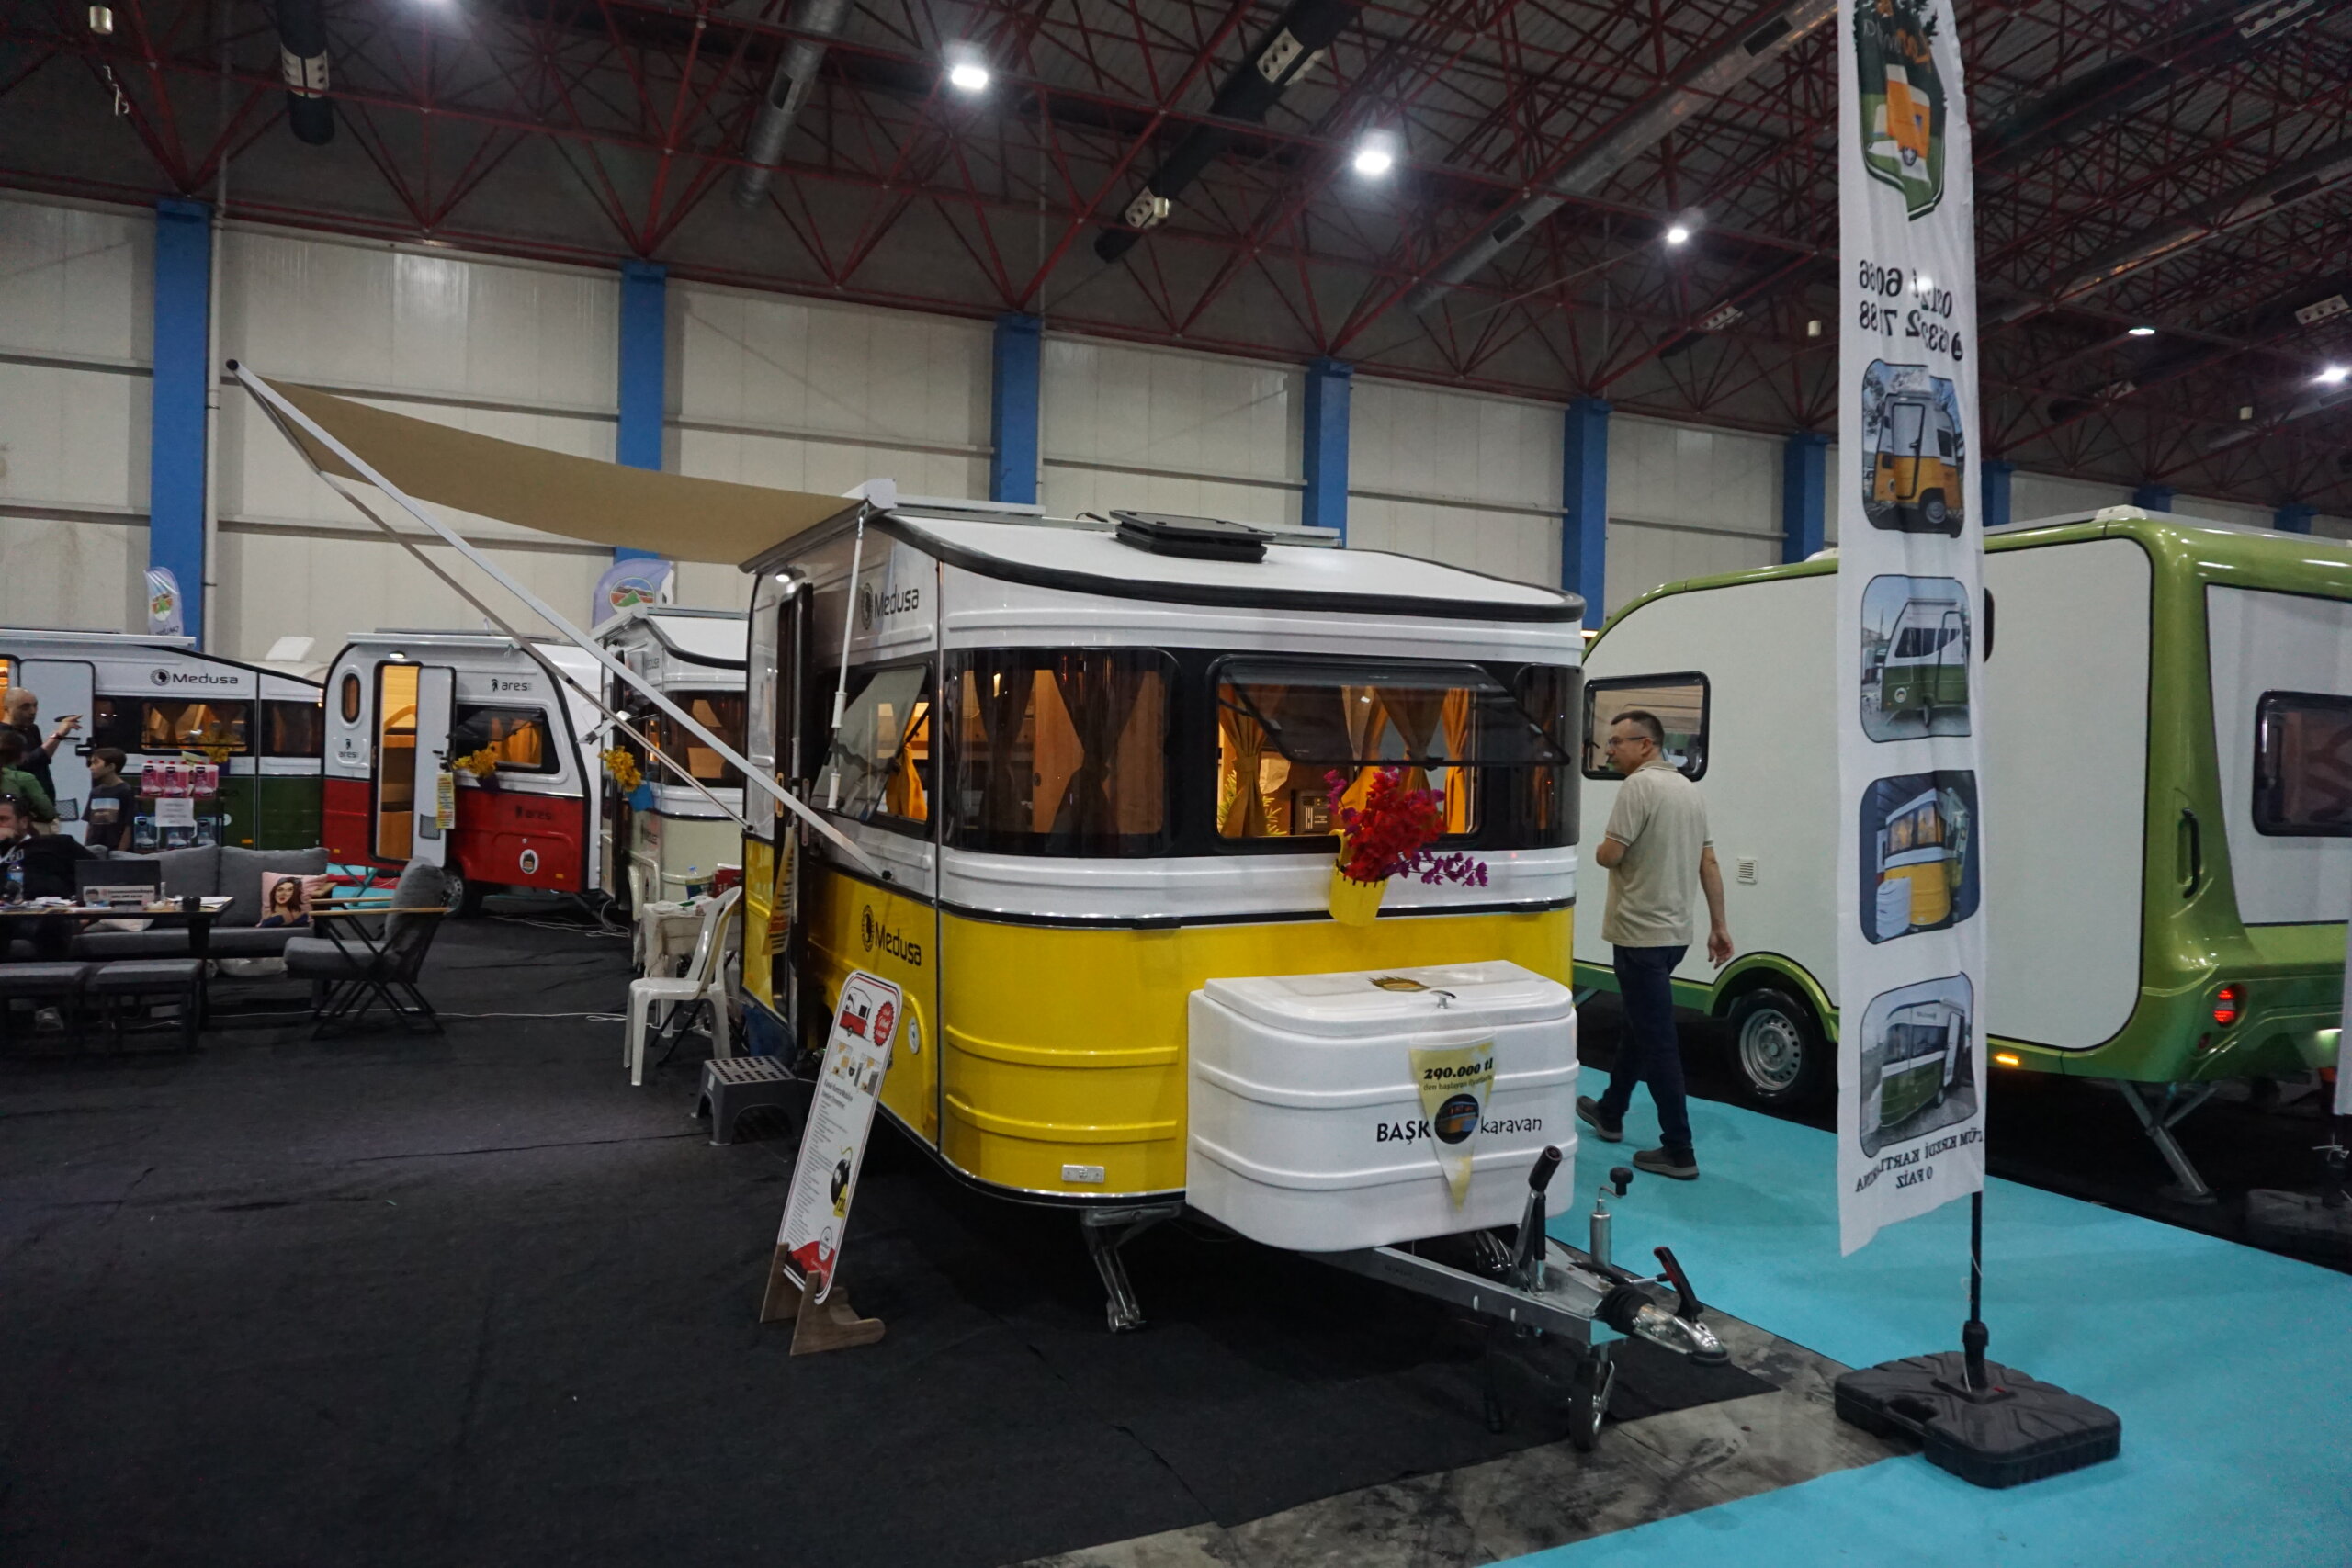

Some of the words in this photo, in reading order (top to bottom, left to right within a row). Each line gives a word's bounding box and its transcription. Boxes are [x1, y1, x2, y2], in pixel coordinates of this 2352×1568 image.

[875, 583, 919, 618] Medusa
[173, 673, 239, 684] Medusa
[502, 682, 527, 691] ares
[875, 921, 922, 967] Medusa
[1424, 1063, 1481, 1080] 290.000
[1485, 1056, 1494, 1071] tl
[1423, 1082, 1437, 1091] den
[1480, 1116, 1542, 1134] karavan
